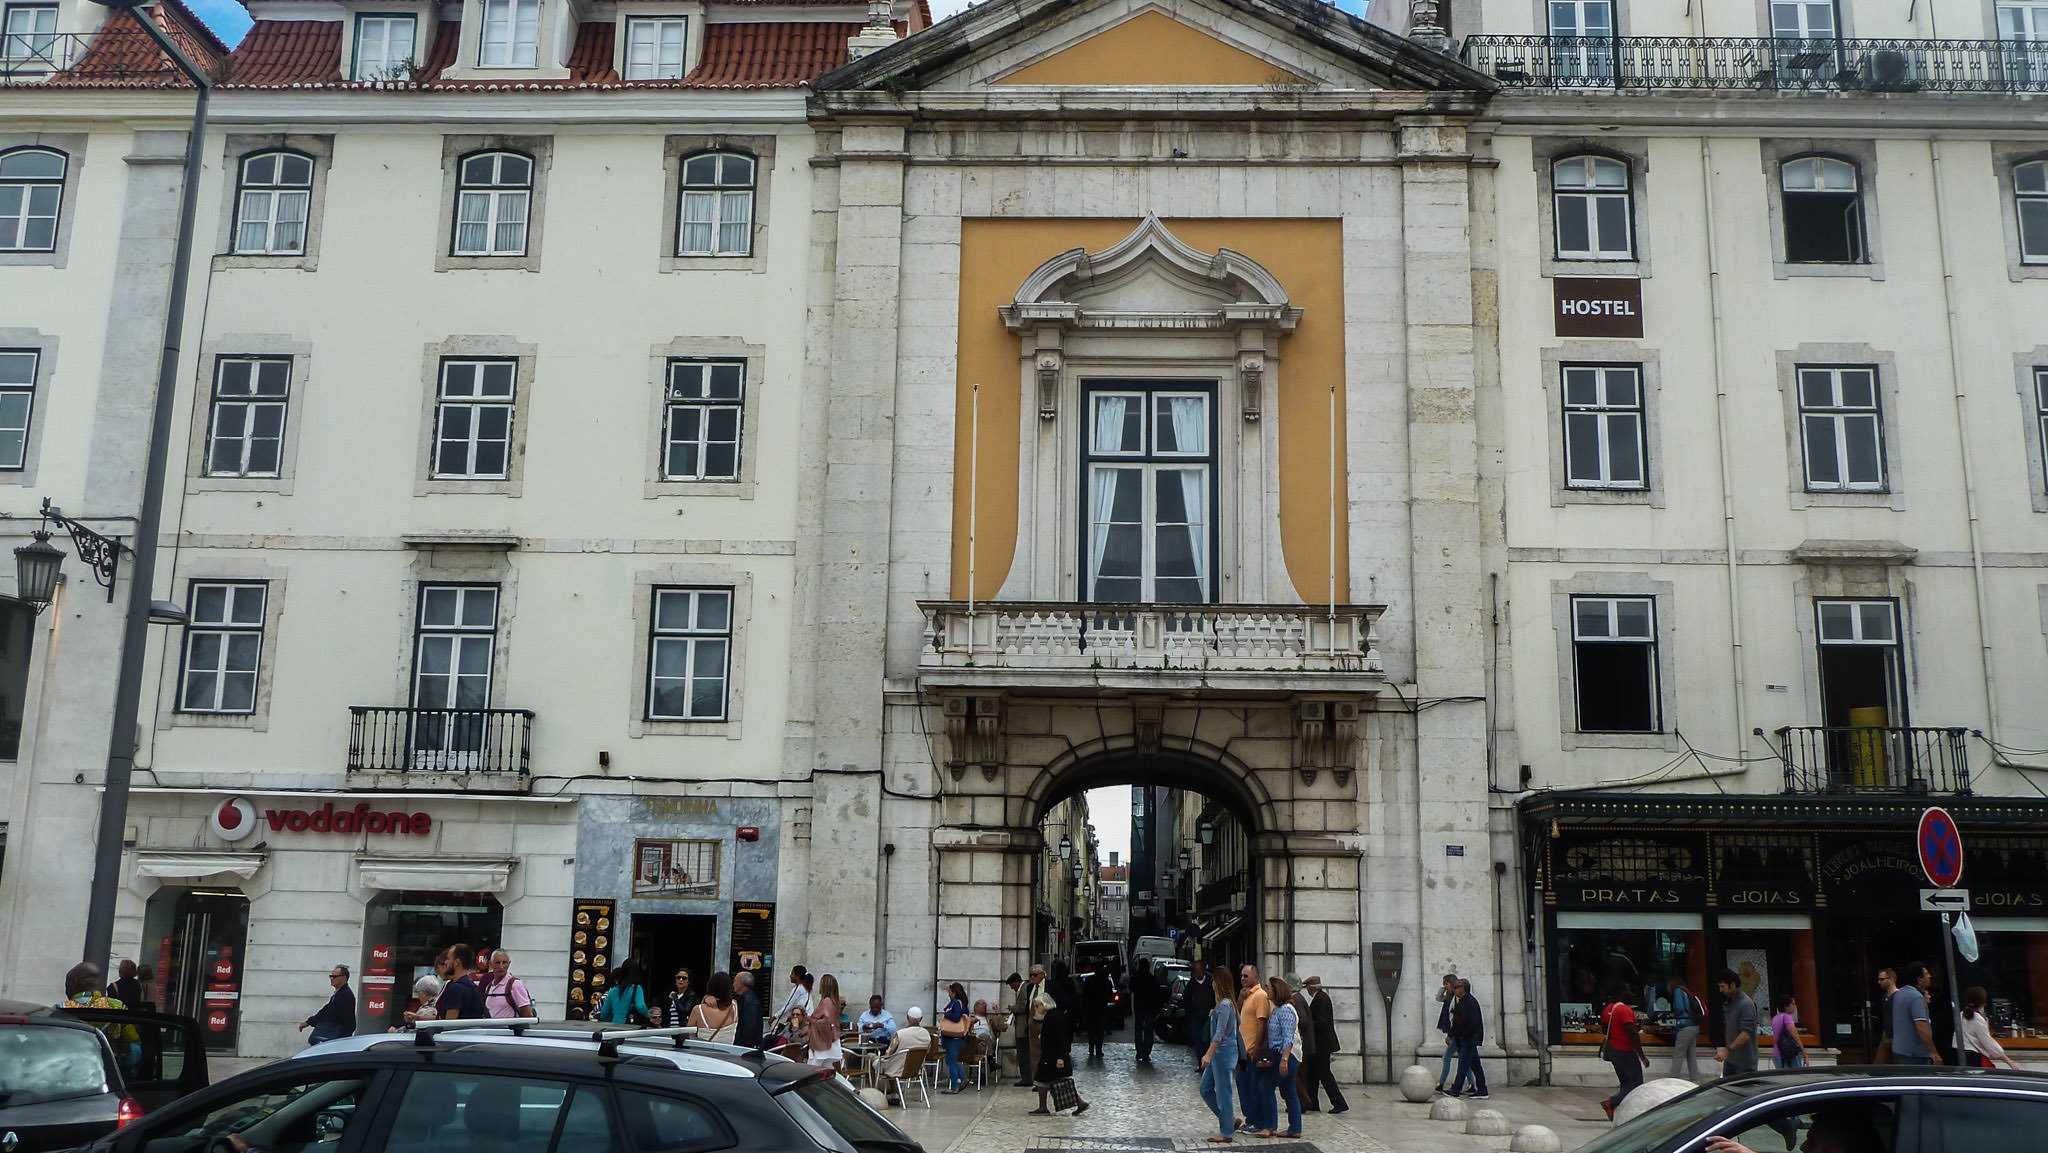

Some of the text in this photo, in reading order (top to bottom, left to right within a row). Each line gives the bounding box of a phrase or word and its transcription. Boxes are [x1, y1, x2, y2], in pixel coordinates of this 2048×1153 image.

[1561, 299, 1635, 316] HOSTEL
[645, 798, 718, 815] TENDINHA
[265, 803, 432, 835] vodafone
[1843, 855, 1925, 881] JOALHEIROS
[1582, 889, 1680, 903] PRATAS
[1731, 890, 1801, 904] JOIAS
[1974, 892, 2043, 906] JOIAS
[1170, 929, 1177, 938] P
[373, 950, 388, 958] Red
[216, 966, 231, 974] Red
[368, 1001, 385, 1009] Red
[210, 1016, 226, 1025] Red
